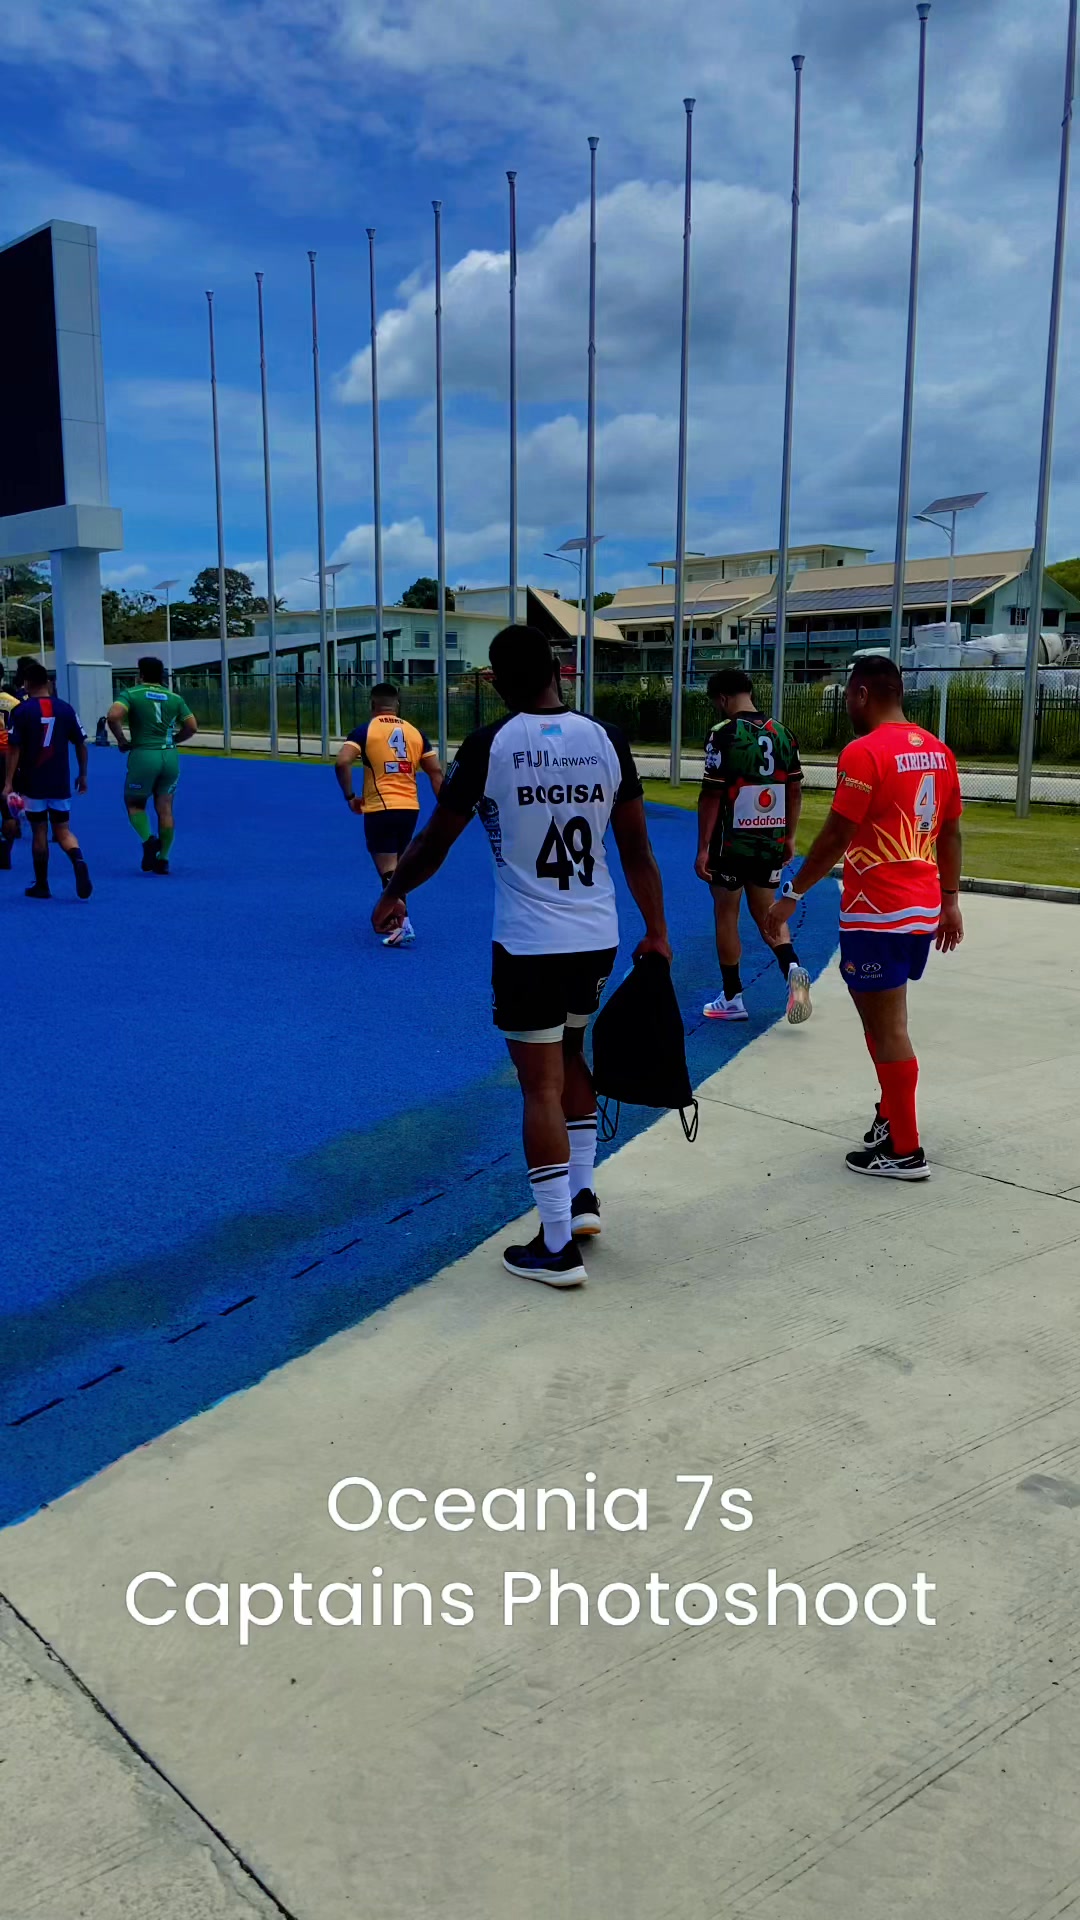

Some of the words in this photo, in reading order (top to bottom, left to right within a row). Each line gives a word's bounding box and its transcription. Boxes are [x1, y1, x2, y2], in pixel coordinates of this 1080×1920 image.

[153, 701, 163, 724] 1
[40, 716, 56, 748] 7
[387, 727, 408, 760] 4
[512, 750, 550, 770] FIJI
[552, 755, 599, 767] AIRWAYS
[758, 735, 775, 776] 3
[894, 751, 948, 773] KIRIBATI
[516, 783, 605, 807] BOGISA
[913, 772, 938, 832] 4
[535, 816, 595, 891] 49
